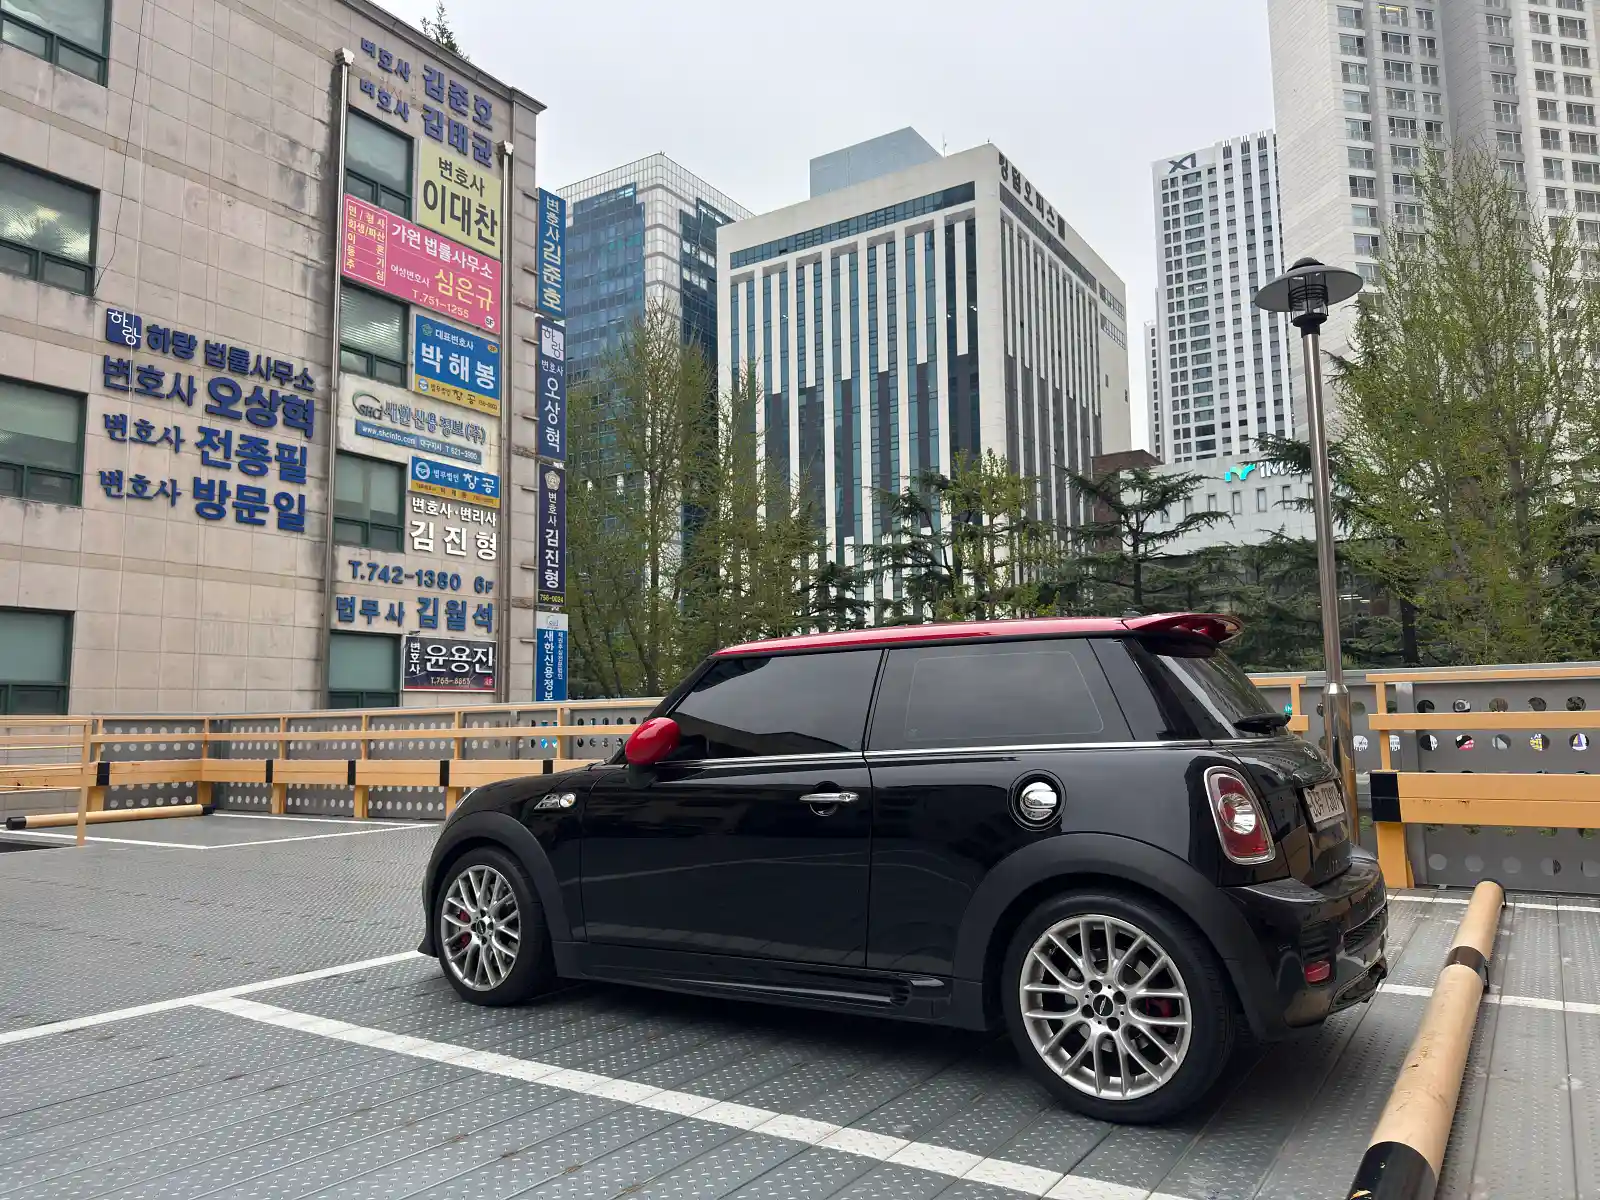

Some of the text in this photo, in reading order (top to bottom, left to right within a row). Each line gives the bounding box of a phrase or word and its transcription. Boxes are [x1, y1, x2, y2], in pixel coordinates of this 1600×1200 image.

[423, 64, 493, 131] 김준호
[439, 157, 485, 197] 변호사
[423, 180, 498, 247] 이대찬
[391, 223, 493, 279] 가원 법률사무소
[390, 264, 494, 312] 여성변호사 심은규
[146, 324, 197, 360] 하랑
[204, 340, 315, 392] 법률사무소
[435, 329, 474, 351] 대표변호사
[421, 343, 496, 390] 박해봉
[542, 360, 563, 376] 변호사
[103, 355, 315, 439] 변호사 오상혁
[545, 378, 560, 452] 오상혁
[103, 413, 307, 485] 변호사 전종필
[99, 469, 306, 532] 변호사 방문일
[463, 473, 494, 493] 창공
[548, 492, 556, 526] 변호사
[410, 520, 496, 560] 김진형
[545, 529, 559, 588] 김진형
[336, 596, 493, 633] 법무사 김월석
[409, 642, 493, 674] 변호사 윤용진
[544, 631, 554, 700] 새한신용정보
